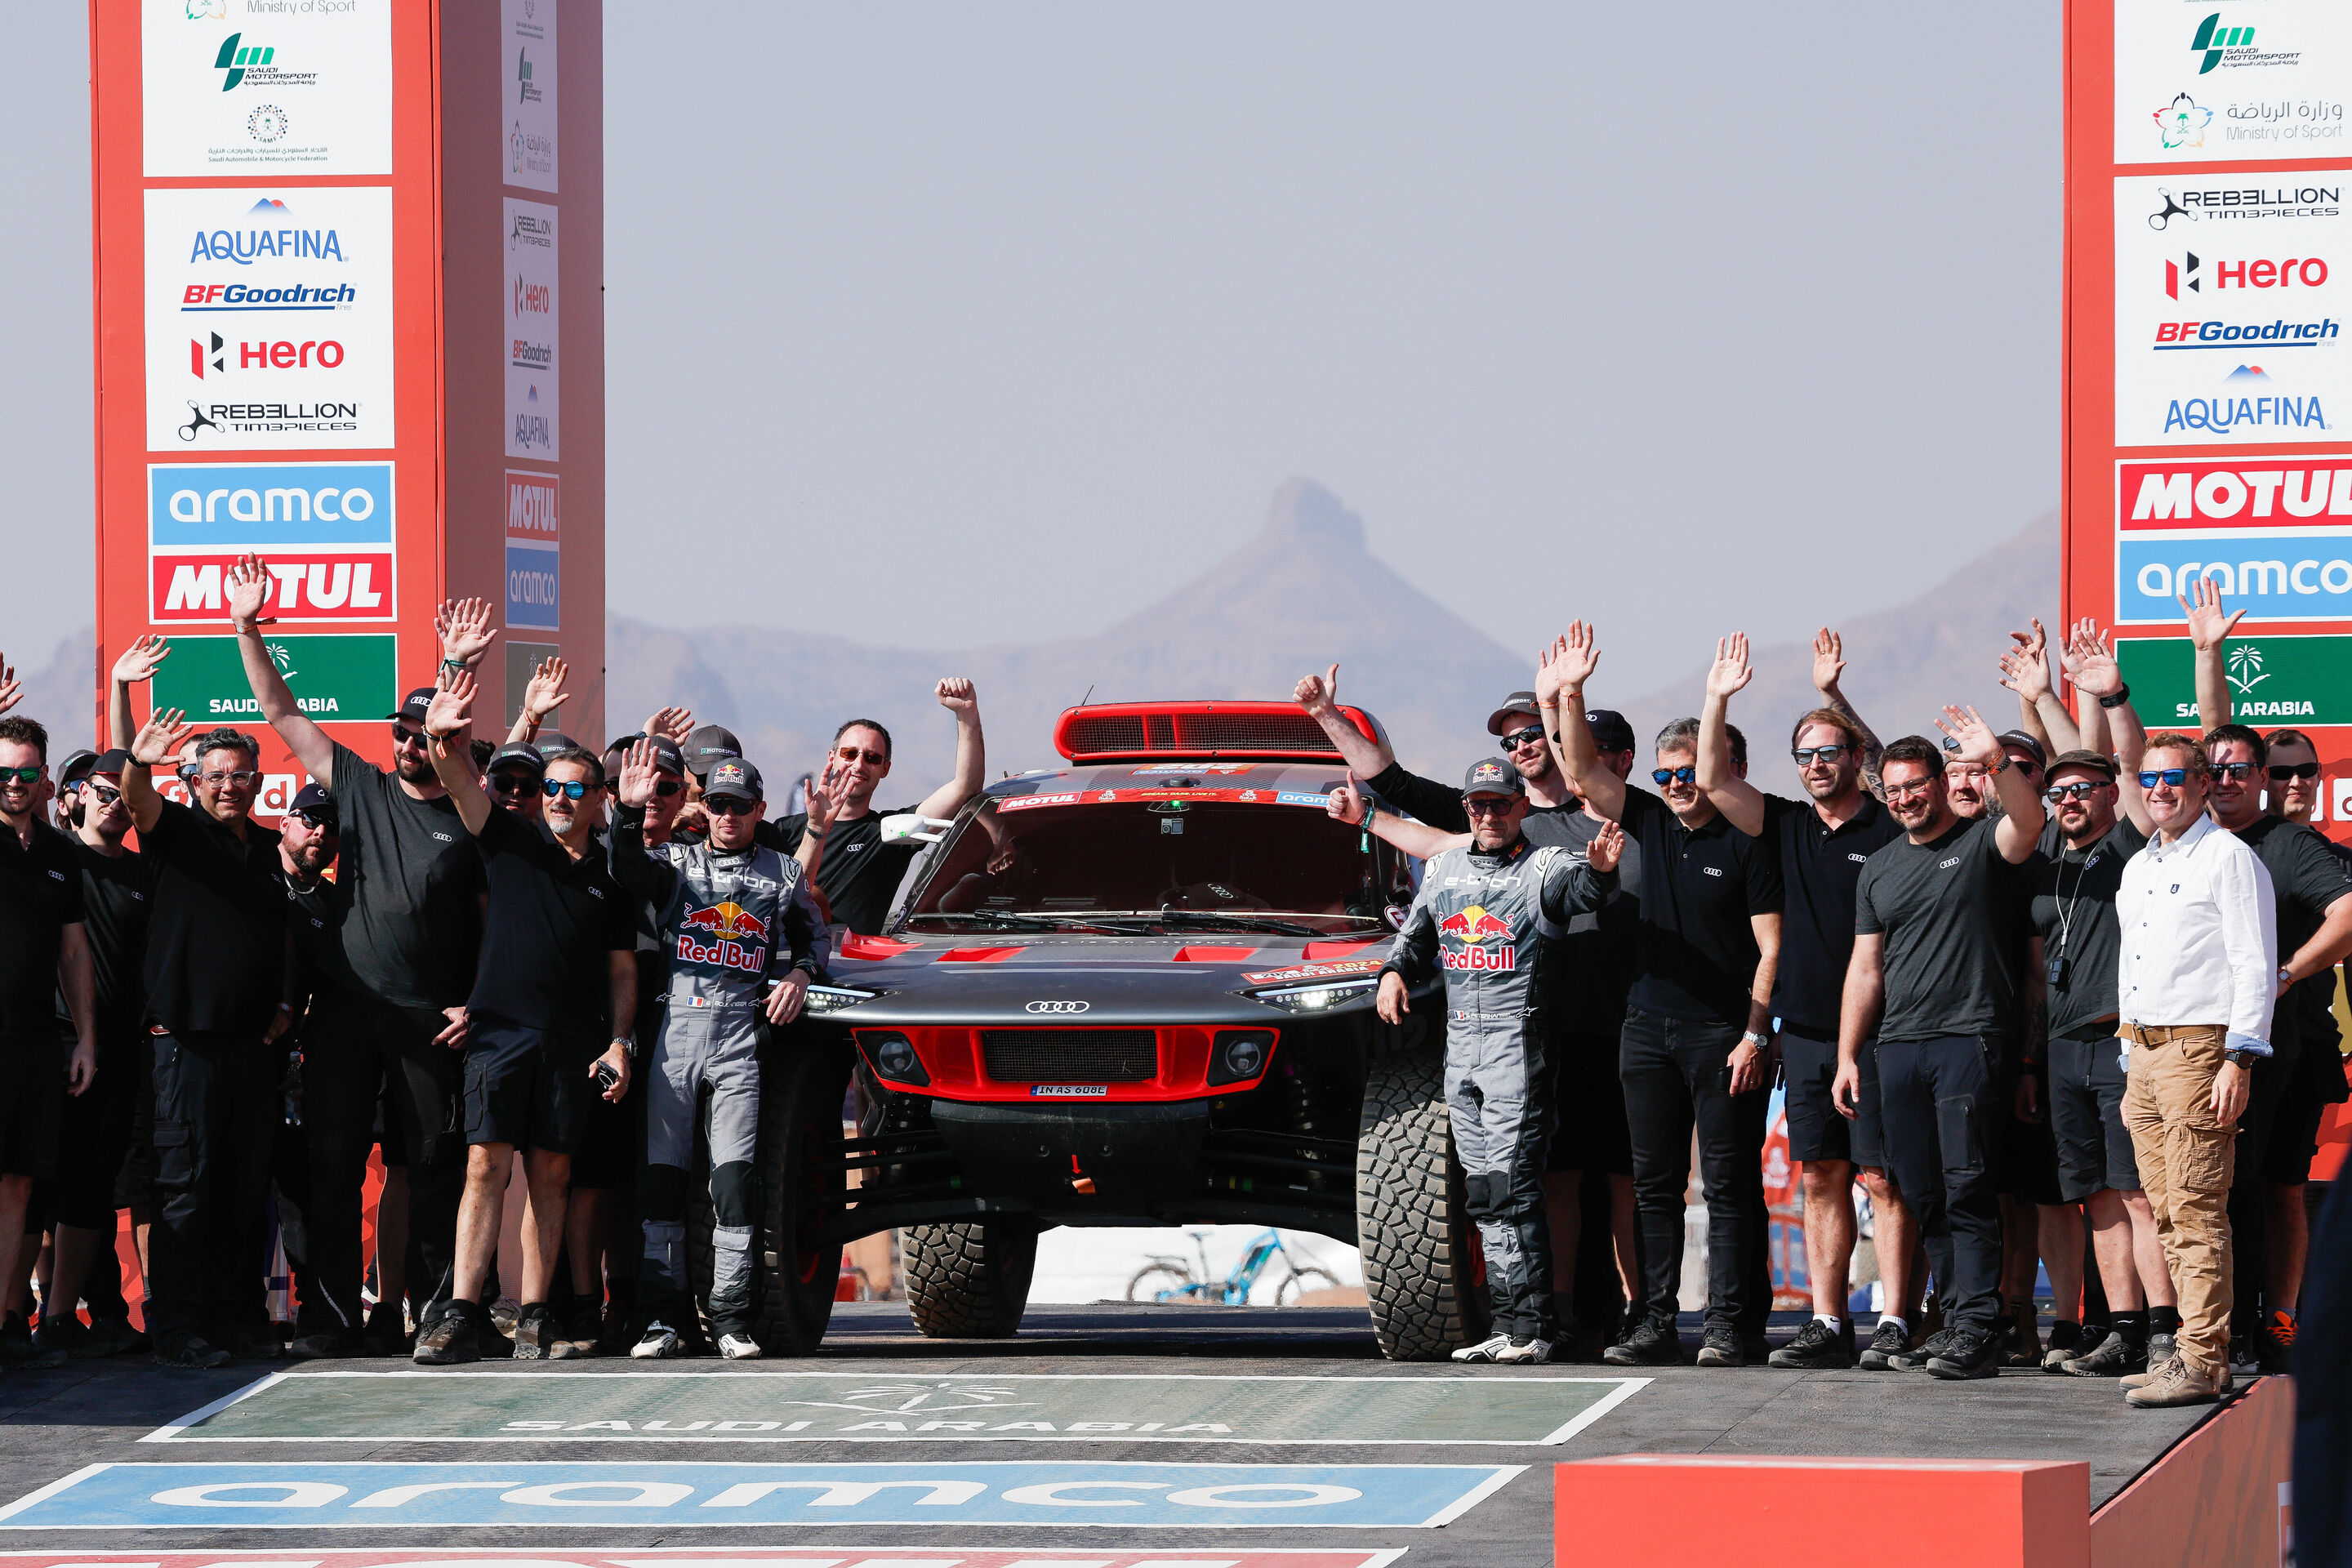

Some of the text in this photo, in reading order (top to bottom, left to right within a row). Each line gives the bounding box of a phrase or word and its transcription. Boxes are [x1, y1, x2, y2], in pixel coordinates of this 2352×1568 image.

[247, 0, 356, 15] Ministry of Sport
[2223, 53, 2301, 61] MOTORSPORT
[2227, 100, 2342, 122] وزارة الرياضة
[2226, 123, 2343, 142] Ministry of Sport
[190, 230, 343, 265] AQUAFINA
[182, 283, 355, 304] BFGoodrich
[2156, 318, 2339, 342] BFGoodrich
[513, 340, 551, 363] BFGoodrich
[2164, 397, 2326, 434] AQUAFINA
[515, 413, 550, 449] AQUAFINA
[2131, 470, 2352, 519] MOTUL
[169, 488, 374, 523] aramco
[509, 484, 556, 531] MOTUL
[510, 570, 555, 605] aramco
[2137, 559, 2352, 597] aramco
[296, 698, 339, 712] ABIA
[2176, 701, 2314, 717] SAI ARABIA
[707, 747, 738, 756] MOTORSPORT
[714, 775, 744, 784] Red Bull
[1473, 773, 1503, 783] Red Bull
[1006, 795, 1076, 808] MOTUL
[1282, 794, 1330, 804] aram
[1444, 873, 1521, 889] e-tron
[677, 934, 765, 973] Red Bull
[1441, 944, 1516, 970] Red Bull
[1273, 972, 1316, 981] SAUDI
[1318, 966, 1369, 975] ARABIA
[1332, 960, 1383, 970] 2024
[499, 1421, 1233, 1433] SAUDI ARABIA
[149, 1481, 1364, 1508] aramco
